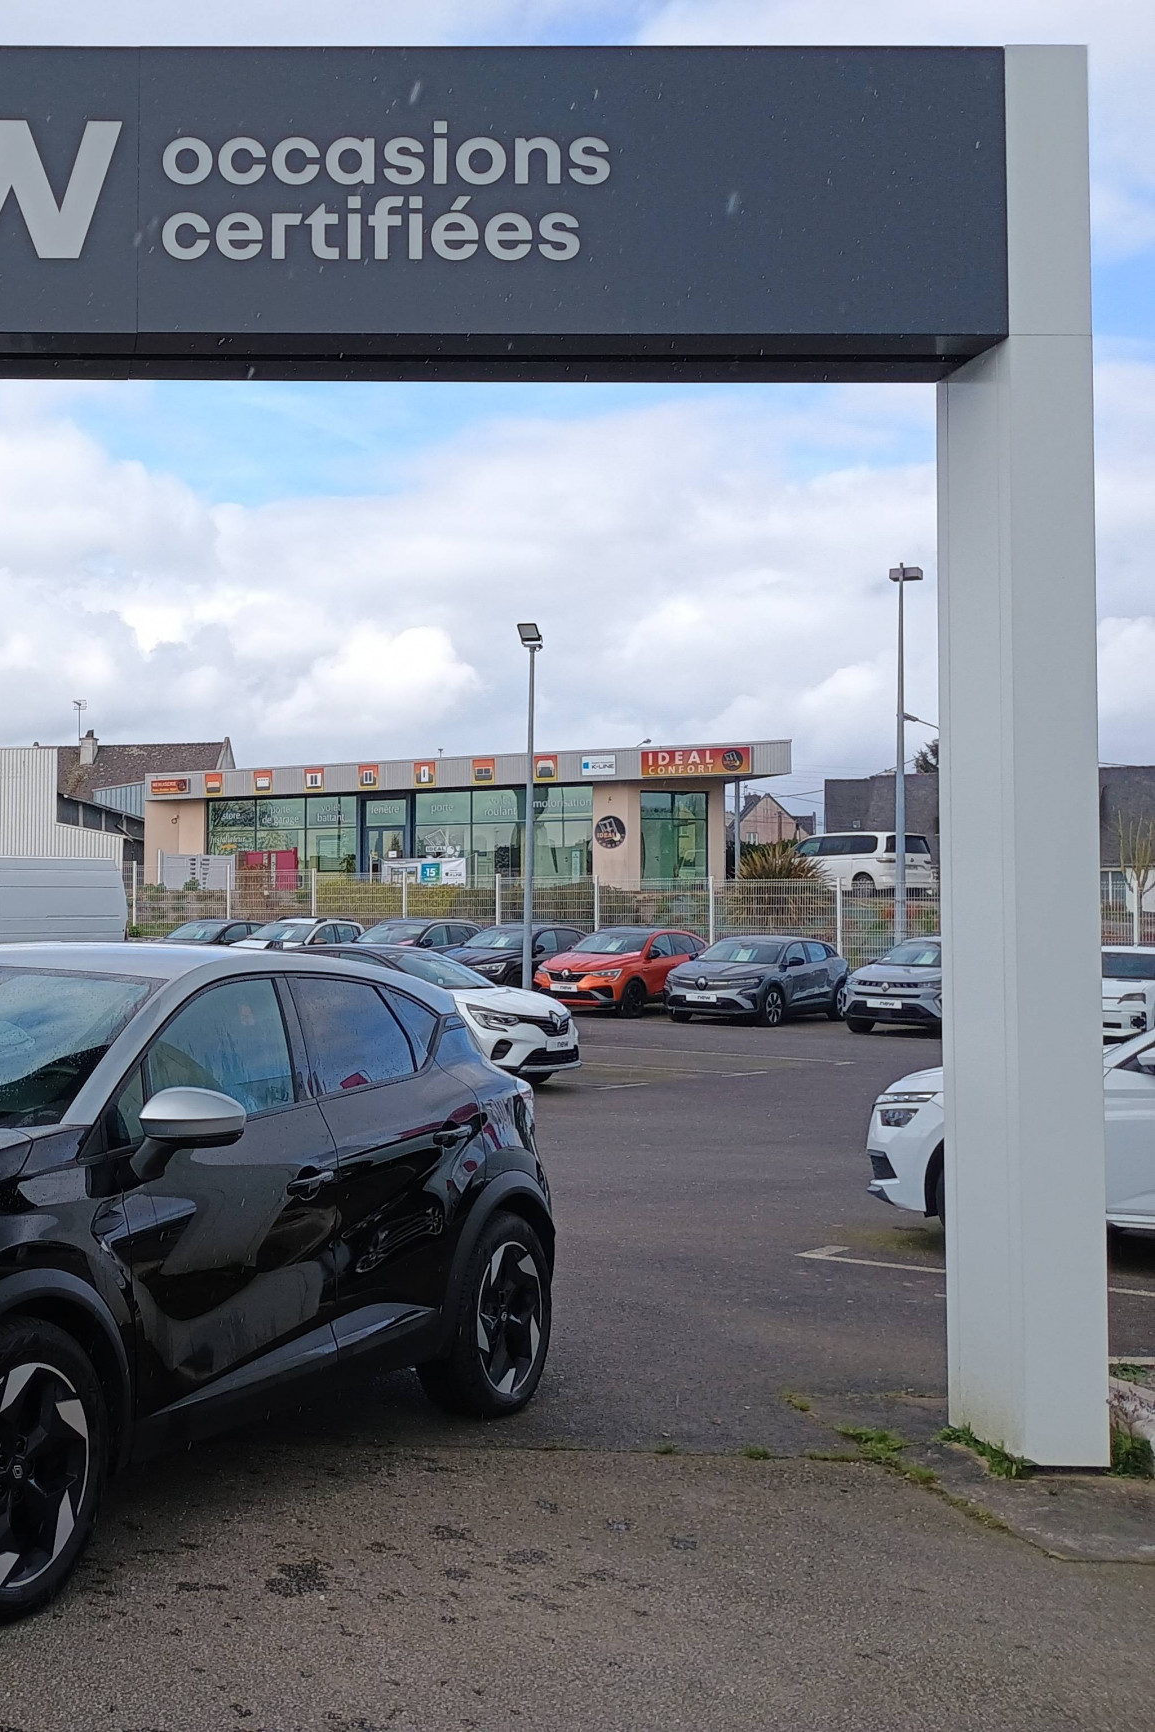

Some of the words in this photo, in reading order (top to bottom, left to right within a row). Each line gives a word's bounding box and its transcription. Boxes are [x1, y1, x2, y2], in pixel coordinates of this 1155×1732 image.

[162, 120, 611, 185] occasions
[161, 195, 580, 261] certifiées
[648, 750, 714, 766] IDEAL
[648, 764, 714, 775] CONFORT
[371, 803, 400, 814] fenêtre
[431, 803, 454, 814] porte
[533, 798, 592, 808] motorisation
[222, 811, 241, 820] store
[484, 804, 517, 816] roulant
[262, 815, 272, 824] de
[273, 815, 299, 827] garage
[317, 812, 345, 822] battant
